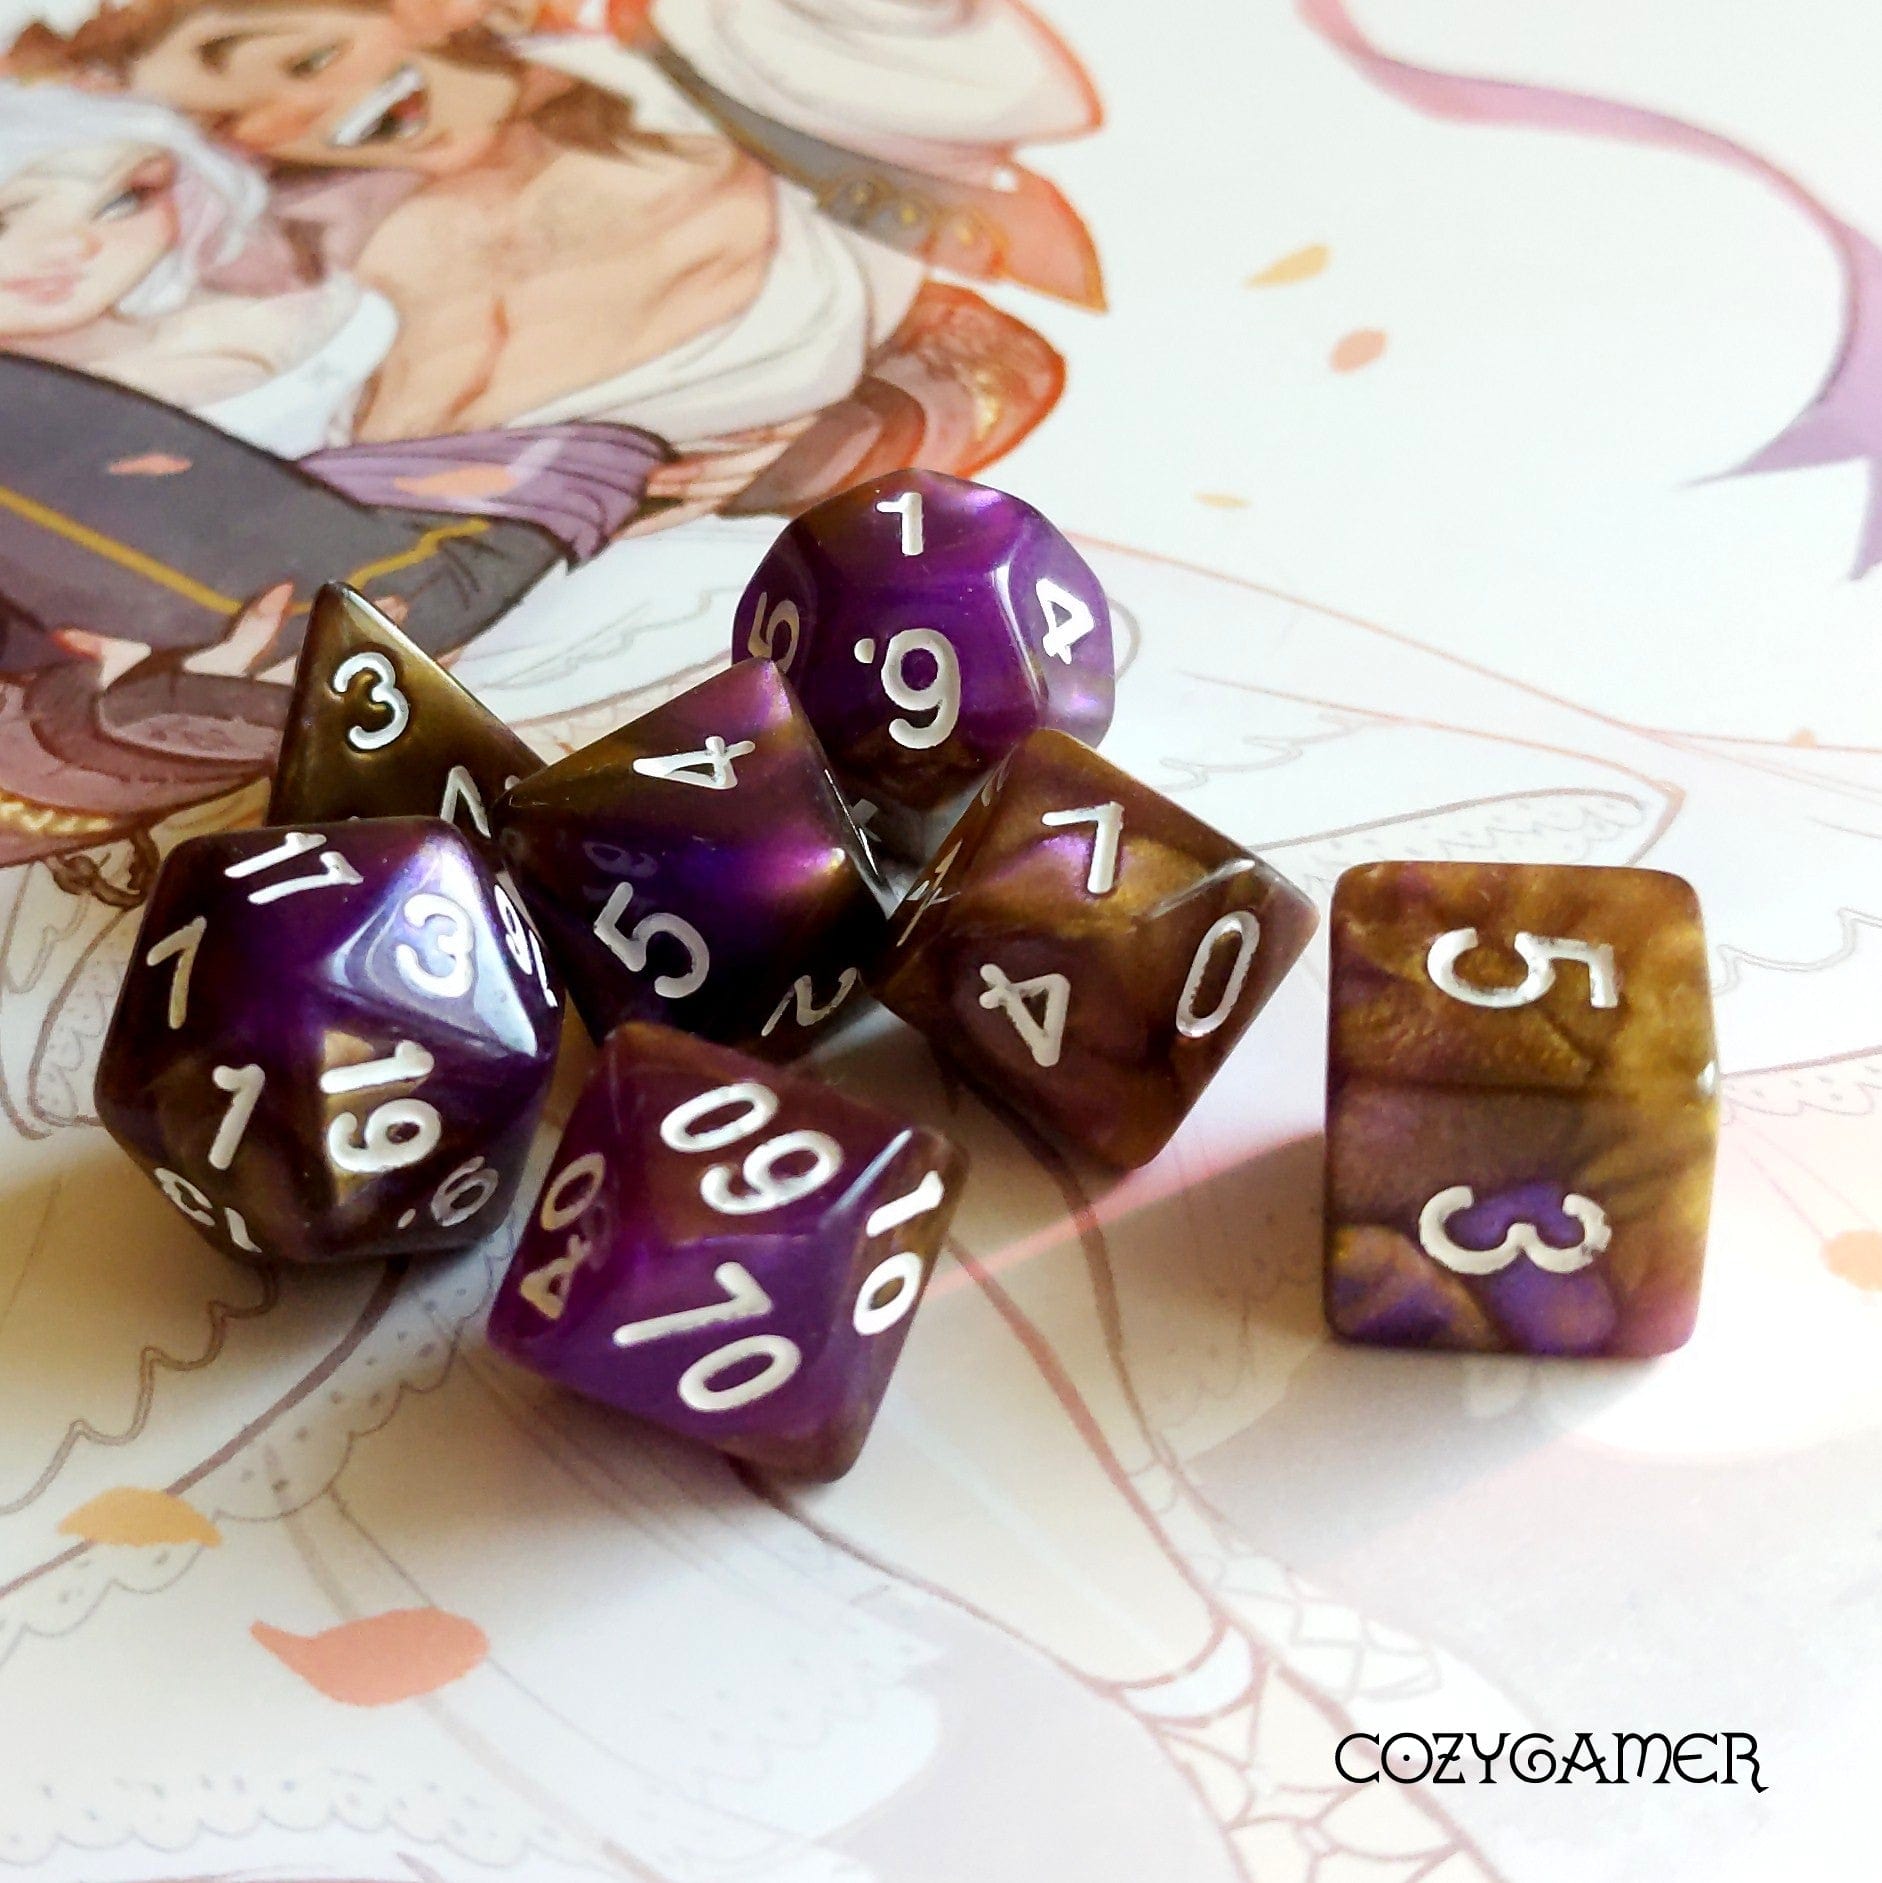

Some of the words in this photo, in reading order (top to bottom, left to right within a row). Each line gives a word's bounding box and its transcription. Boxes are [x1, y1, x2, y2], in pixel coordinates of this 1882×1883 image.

[747, 591, 799, 674] 5
[1035, 578, 1095, 665] 4
[332, 651, 410, 751] 3
[633, 735, 755, 789] 4
[394, 893, 475, 998] 3
[594, 881, 710, 998] 5
[1427, 927, 1618, 1008] 5
[980, 964, 1071, 1067] 4
[1419, 1186, 1612, 1274] 3
